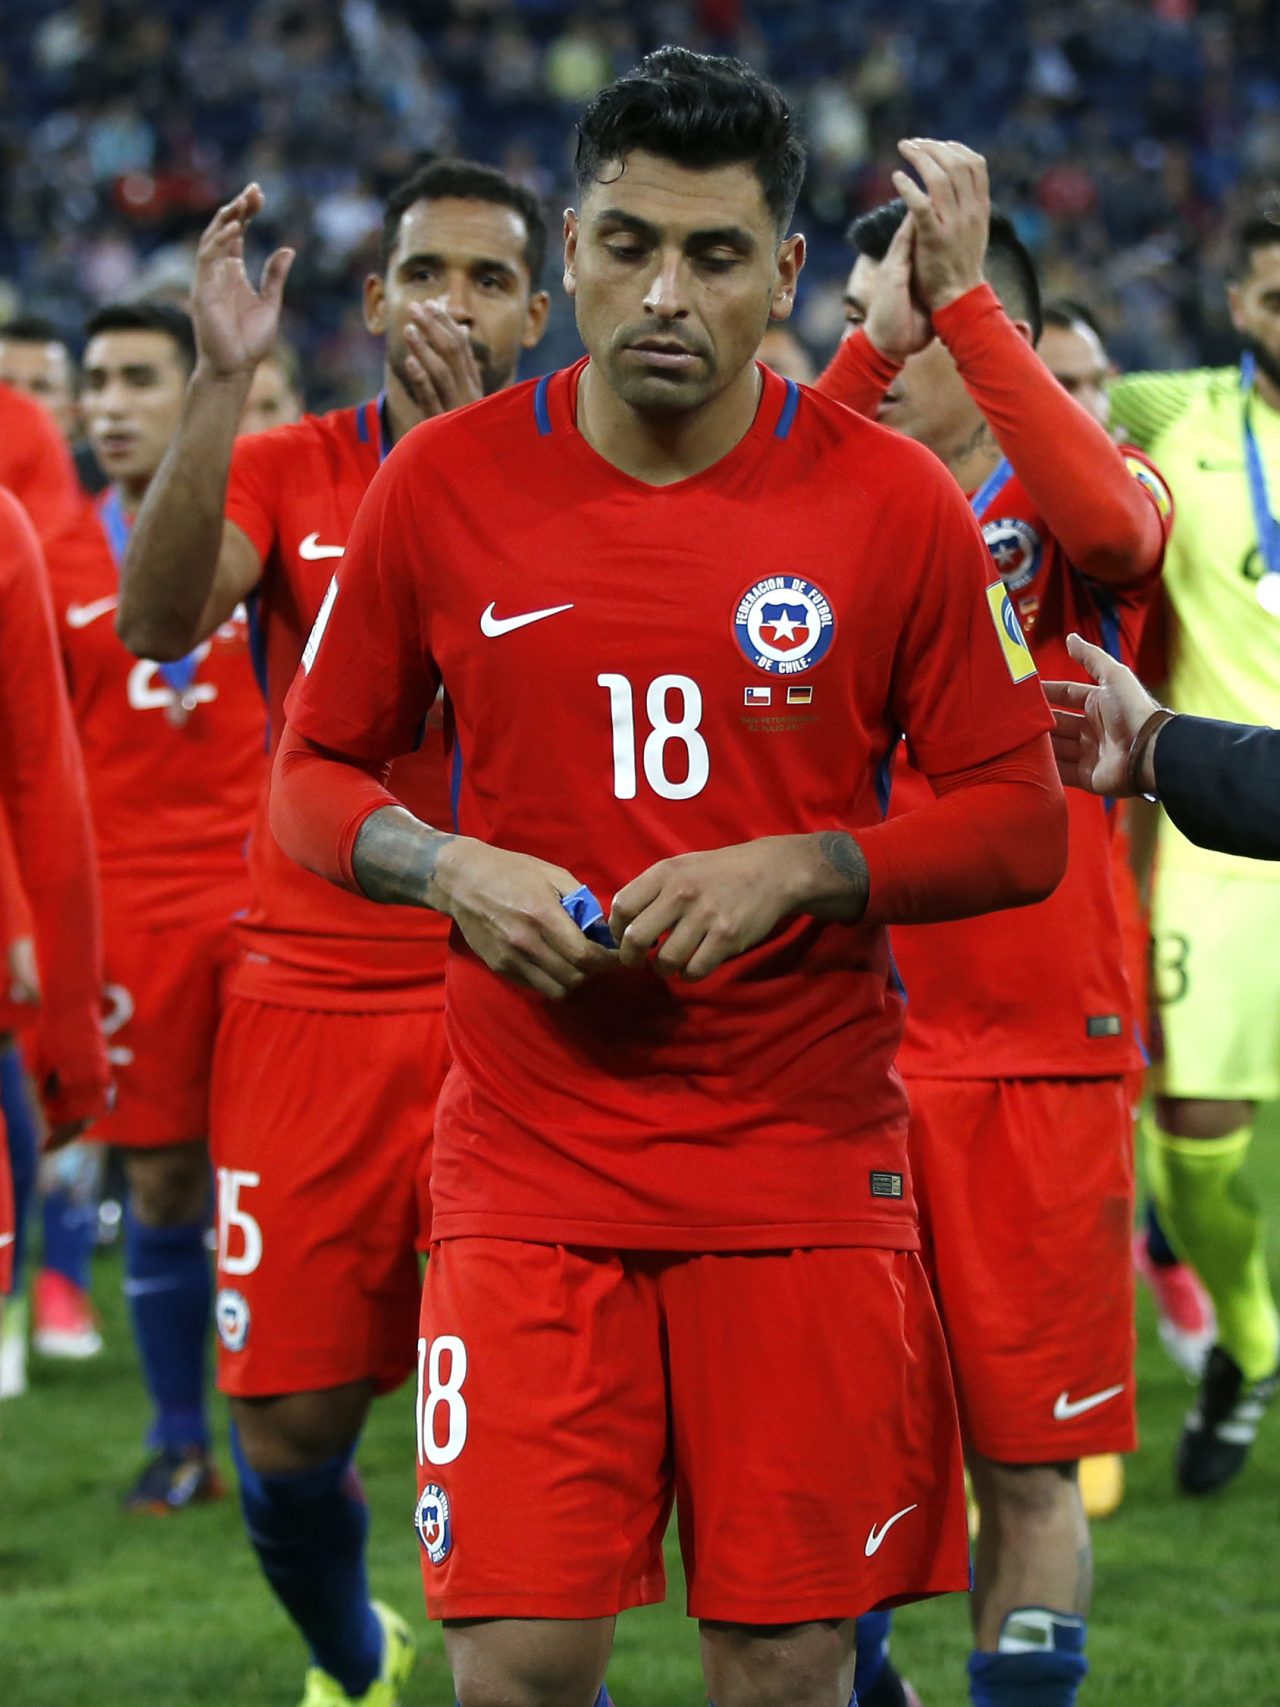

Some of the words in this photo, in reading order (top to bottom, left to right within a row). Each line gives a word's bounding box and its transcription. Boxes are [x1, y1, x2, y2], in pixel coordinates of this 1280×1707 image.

[735, 576, 785, 625] FEDERACION
[791, 578, 807, 593] DE
[807, 588, 833, 628] FUTBOL
[757, 655, 773, 671] DE
[778, 657, 809, 674] CHILE
[596, 672, 710, 800] 18
[415, 1334, 469, 1467] 18
